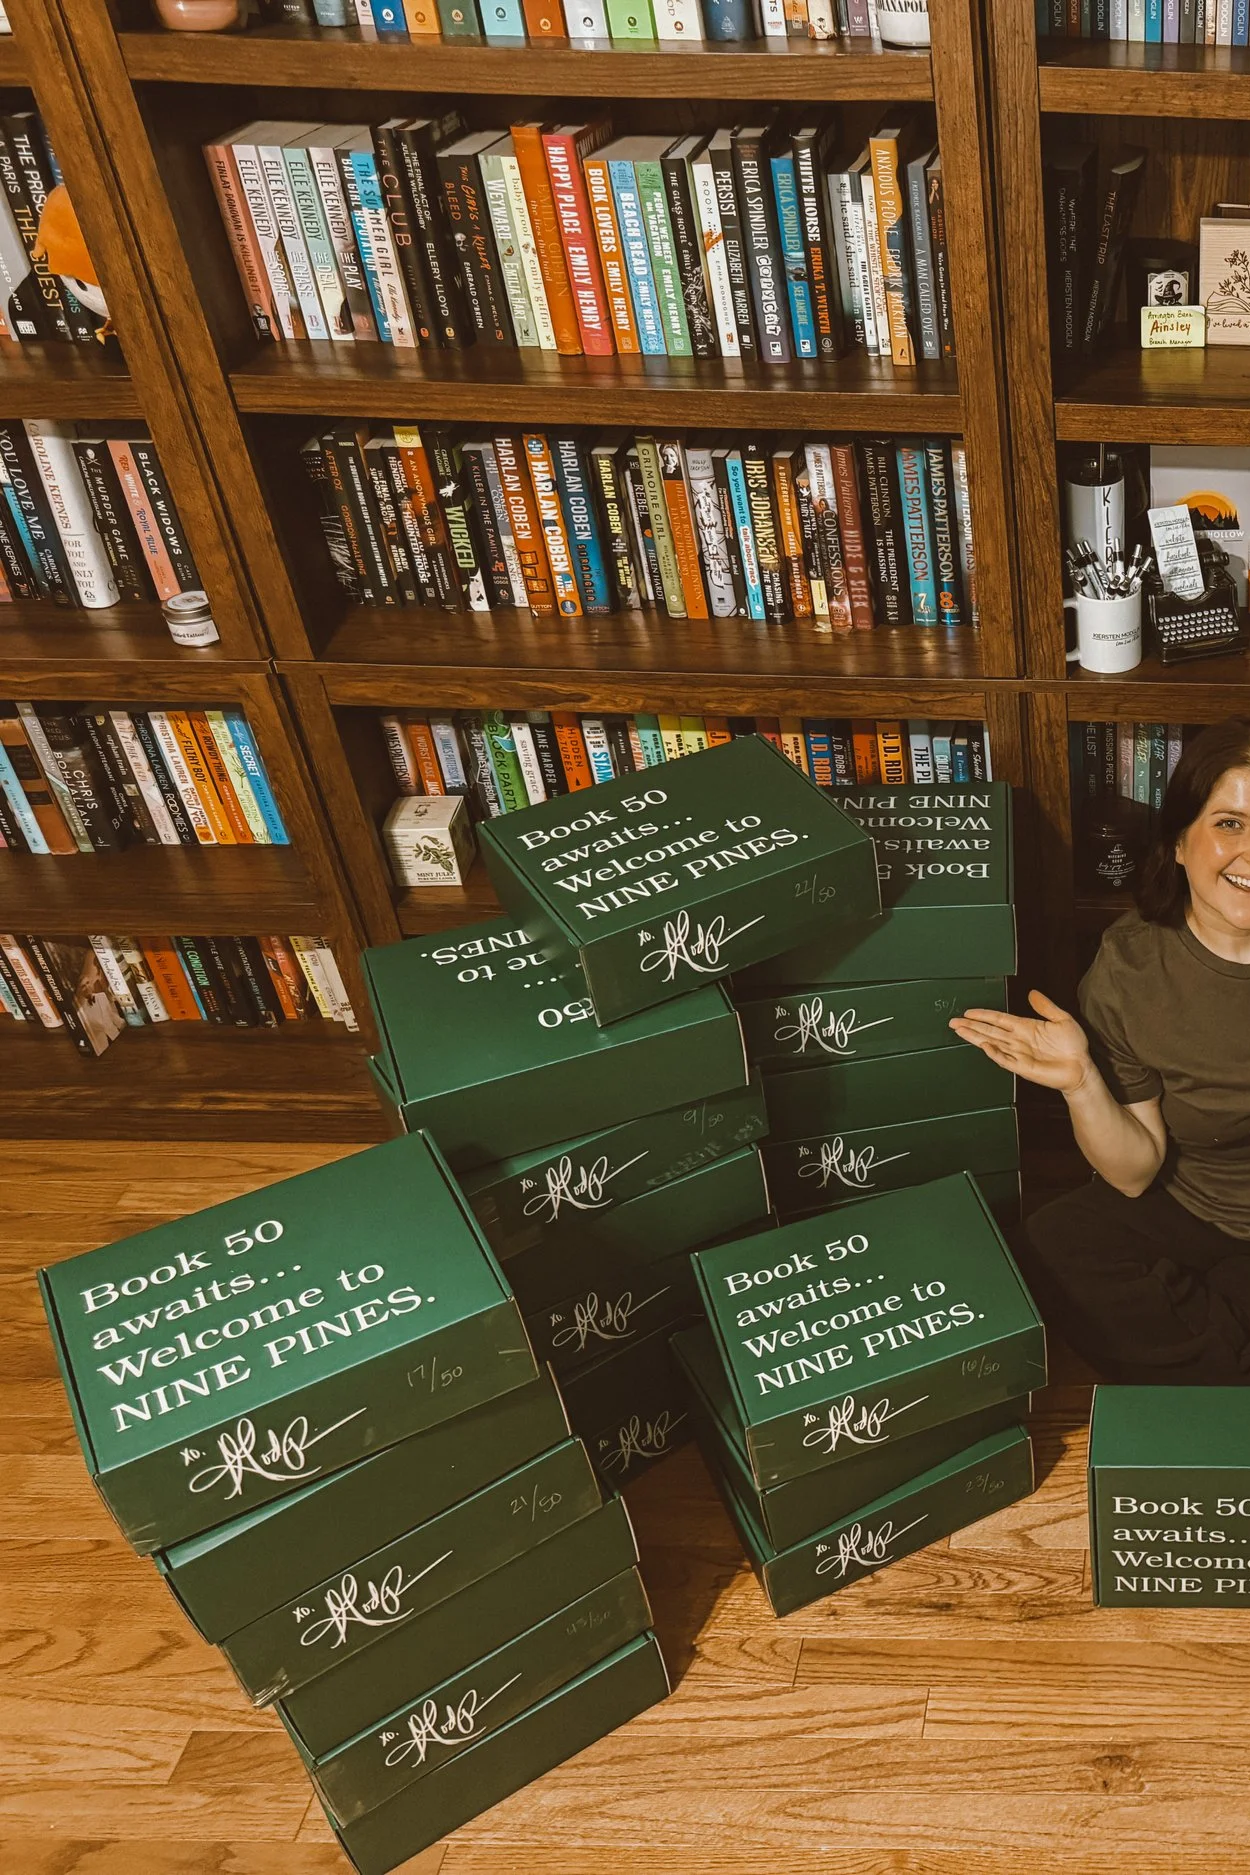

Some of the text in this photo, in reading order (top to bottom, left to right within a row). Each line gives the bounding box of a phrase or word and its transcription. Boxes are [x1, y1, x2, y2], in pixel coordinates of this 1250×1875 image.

[14, 207, 39, 244] THE
[383, 175, 412, 247] CLUB
[547, 146, 581, 235] HAPPY PLACE
[588, 168, 616, 253] BOOK LOVERS
[715, 170, 736, 217] PERSIST
[741, 160, 769, 250] ERICA SPINDLER
[799, 147, 821, 242] WHITE HORSE
[619, 192, 648, 276] BEACH READ
[425, 242, 450, 318] ELLERY LLOYD
[568, 247, 602, 330] EMILY HENRY
[726, 239, 750, 325] ELIZABETH WARREN
[1150, 320, 1192, 336] Ainsley
[1222, 320, 1242, 330] lived
[27, 422, 72, 530] CAROLINE KEPNES
[138, 452, 182, 555] BLACK WIDOWS
[495, 437, 534, 541] HARLAN COBEN
[558, 440, 593, 541] HARLAN COBEN
[446, 505, 476, 569] WICKED
[926, 448, 955, 583] JAMES PATTERSON
[1207, 530, 1246, 539] HOLLOW
[182, 737, 208, 783] FILTHY BOY
[239, 745, 260, 777] SECRET
[535, 728, 556, 785] JANE HARPER
[517, 789, 668, 851] Book 50
[907, 793, 991, 809] NINE
[541, 816, 693, 872] awaits...
[553, 815, 762, 894] Welcome to
[575, 828, 809, 920] NINE PINES.
[904, 863, 990, 879] Book
[80, 1220, 284, 1314] Book 50
[723, 1234, 869, 1296] Book 50
[736, 1274, 884, 1326] awaits...
[93, 1264, 302, 1351] awaits...
[97, 1264, 384, 1387] Welcome to
[742, 1281, 946, 1359] Welcome to
[111, 1286, 436, 1433] NINE PINES.
[407, 1357, 463, 1393] 17/50
[754, 1302, 985, 1396] NINE PINES.
[1112, 1496, 1203, 1516] Book
[1114, 1576, 1203, 1593] NINE
